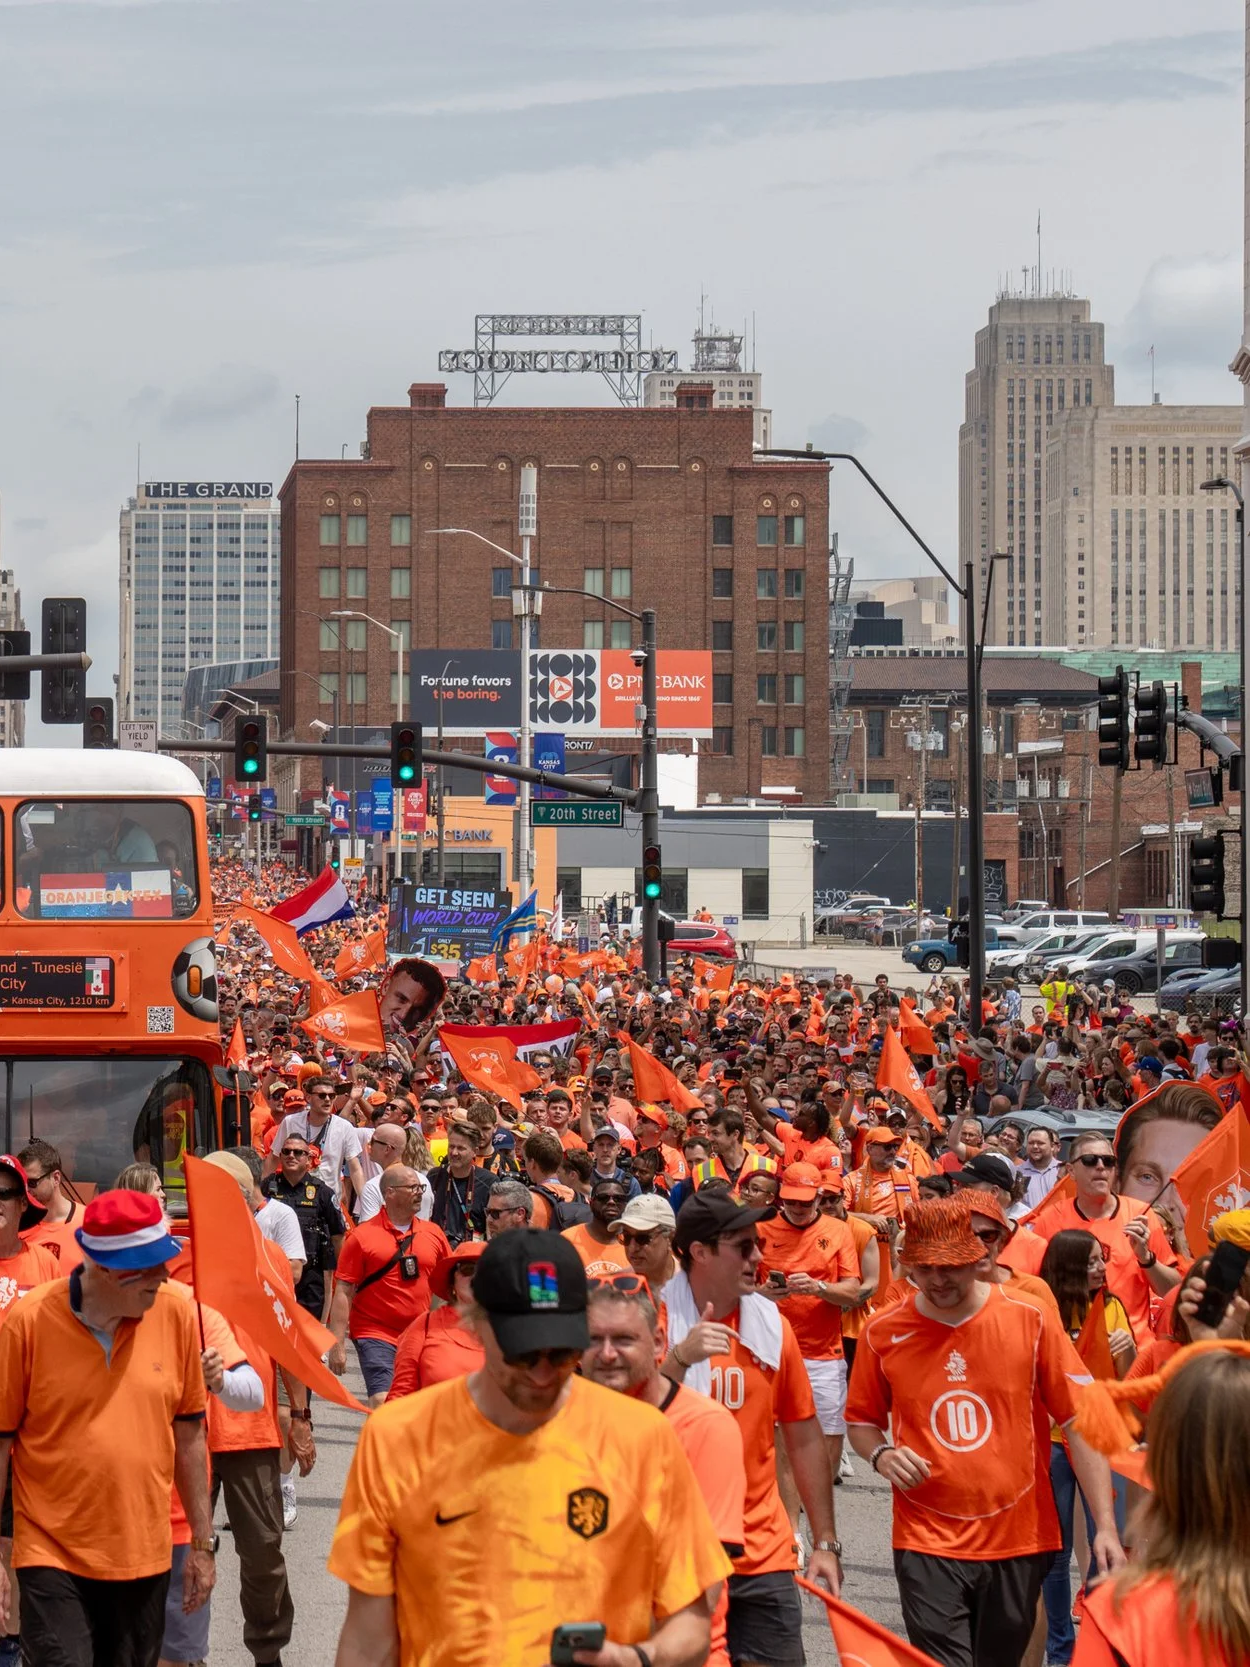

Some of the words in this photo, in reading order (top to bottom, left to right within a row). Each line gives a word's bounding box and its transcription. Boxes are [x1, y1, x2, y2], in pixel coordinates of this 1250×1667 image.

[145, 483, 188, 497] THE
[196, 483, 273, 497] GRAND
[471, 675, 512, 687] favors
[457, 688, 502, 702] boring.
[127, 732, 149, 740] YIELD
[133, 741, 143, 749] ON
[550, 807, 576, 820] 20th
[581, 807, 617, 820] Street
[415, 887, 448, 905] GET
[451, 889, 496, 909] SEEN
[437, 904, 460, 912] DURING
[412, 908, 463, 926] WORLD
[465, 910, 501, 927] CUP!
[430, 943, 461, 960] $35
[31, 961, 84, 974] Tunesië
[0, 977, 27, 992] City
[11, 996, 44, 1005] Kansas
[45, 996, 67, 1007] City,
[70, 996, 93, 1005] 1210
[95, 996, 110, 1005] km
[710, 1366, 745, 1410] 10
[946, 1399, 979, 1443] 10
